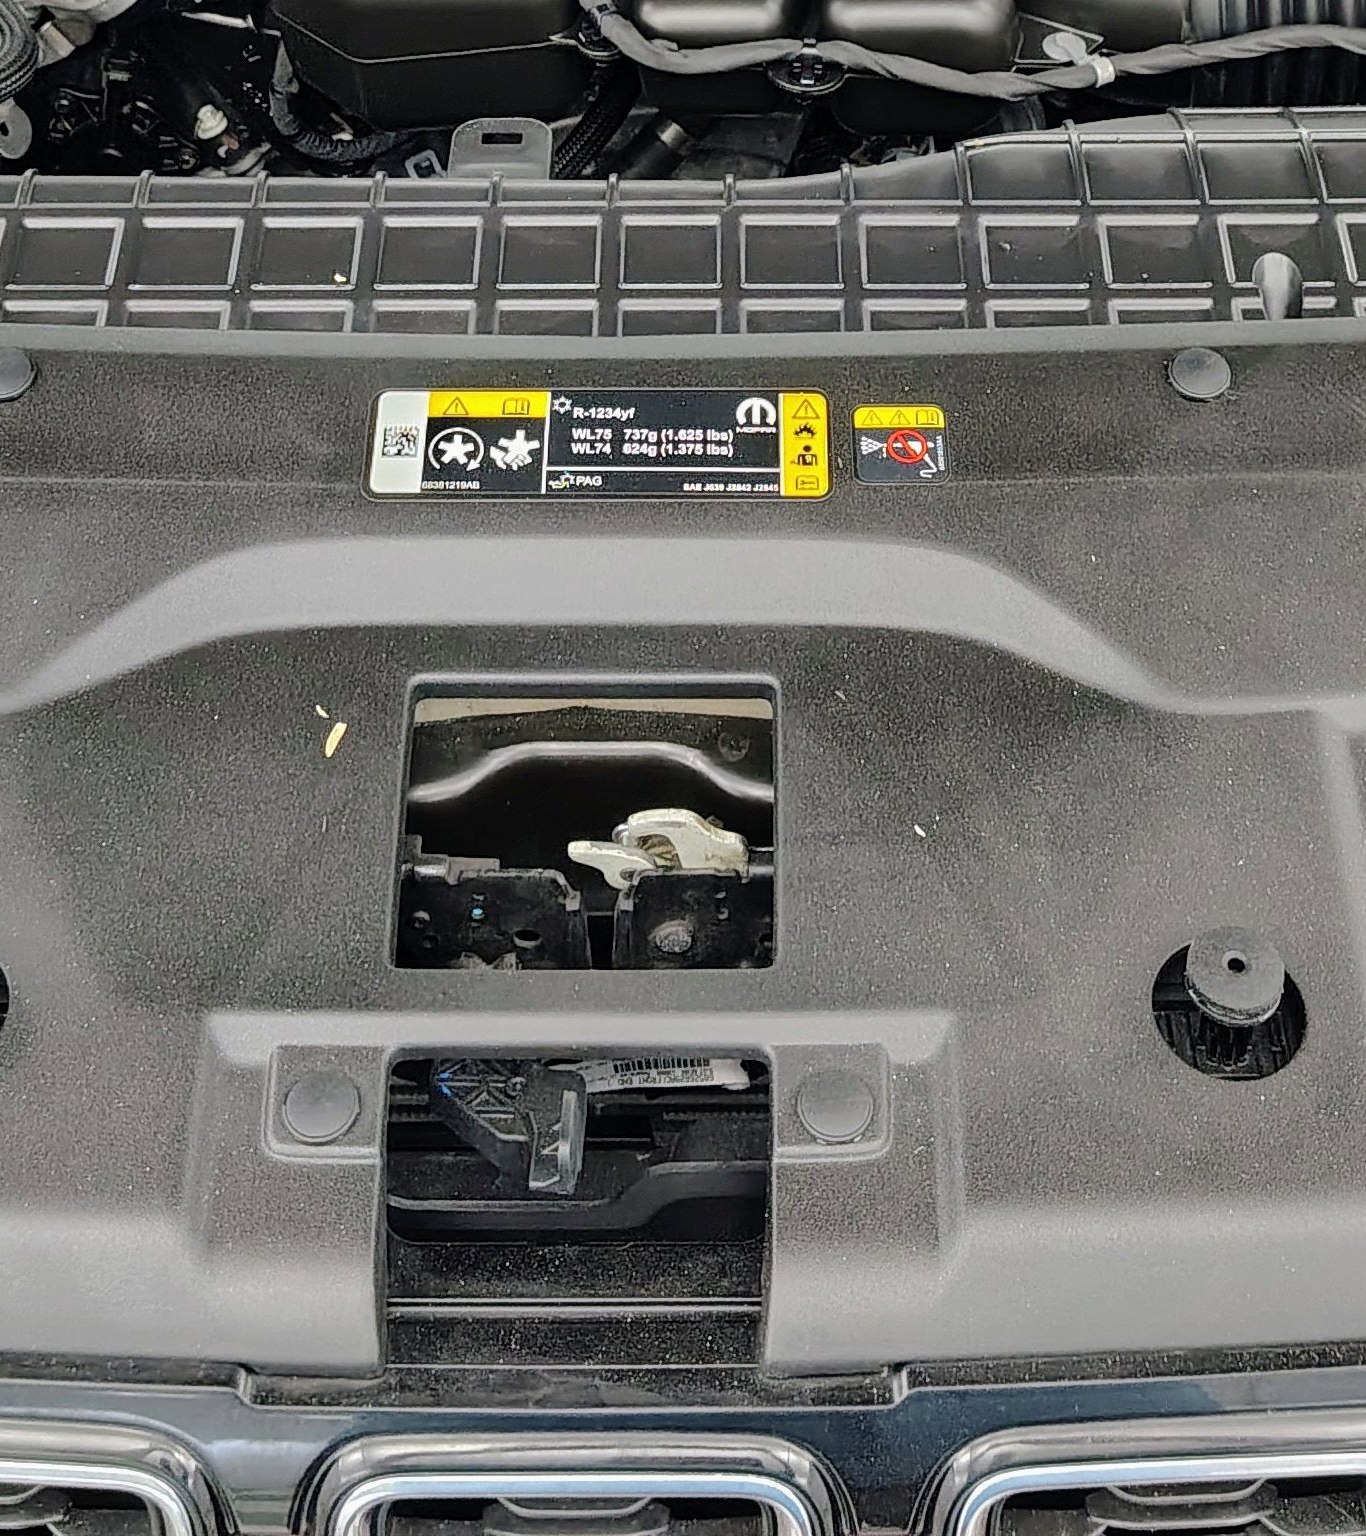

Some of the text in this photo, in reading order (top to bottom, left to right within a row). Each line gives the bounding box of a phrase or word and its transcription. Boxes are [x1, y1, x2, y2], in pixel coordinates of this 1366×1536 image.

[573, 407, 636, 421] R-1234yf
[571, 428, 613, 440] WL75
[623, 428, 658, 443] 737g
[706, 429, 734, 443] lbs)
[571, 442, 734, 457] WL74 624g (1.375 lbs)
[575, 475, 603, 486] PAG
